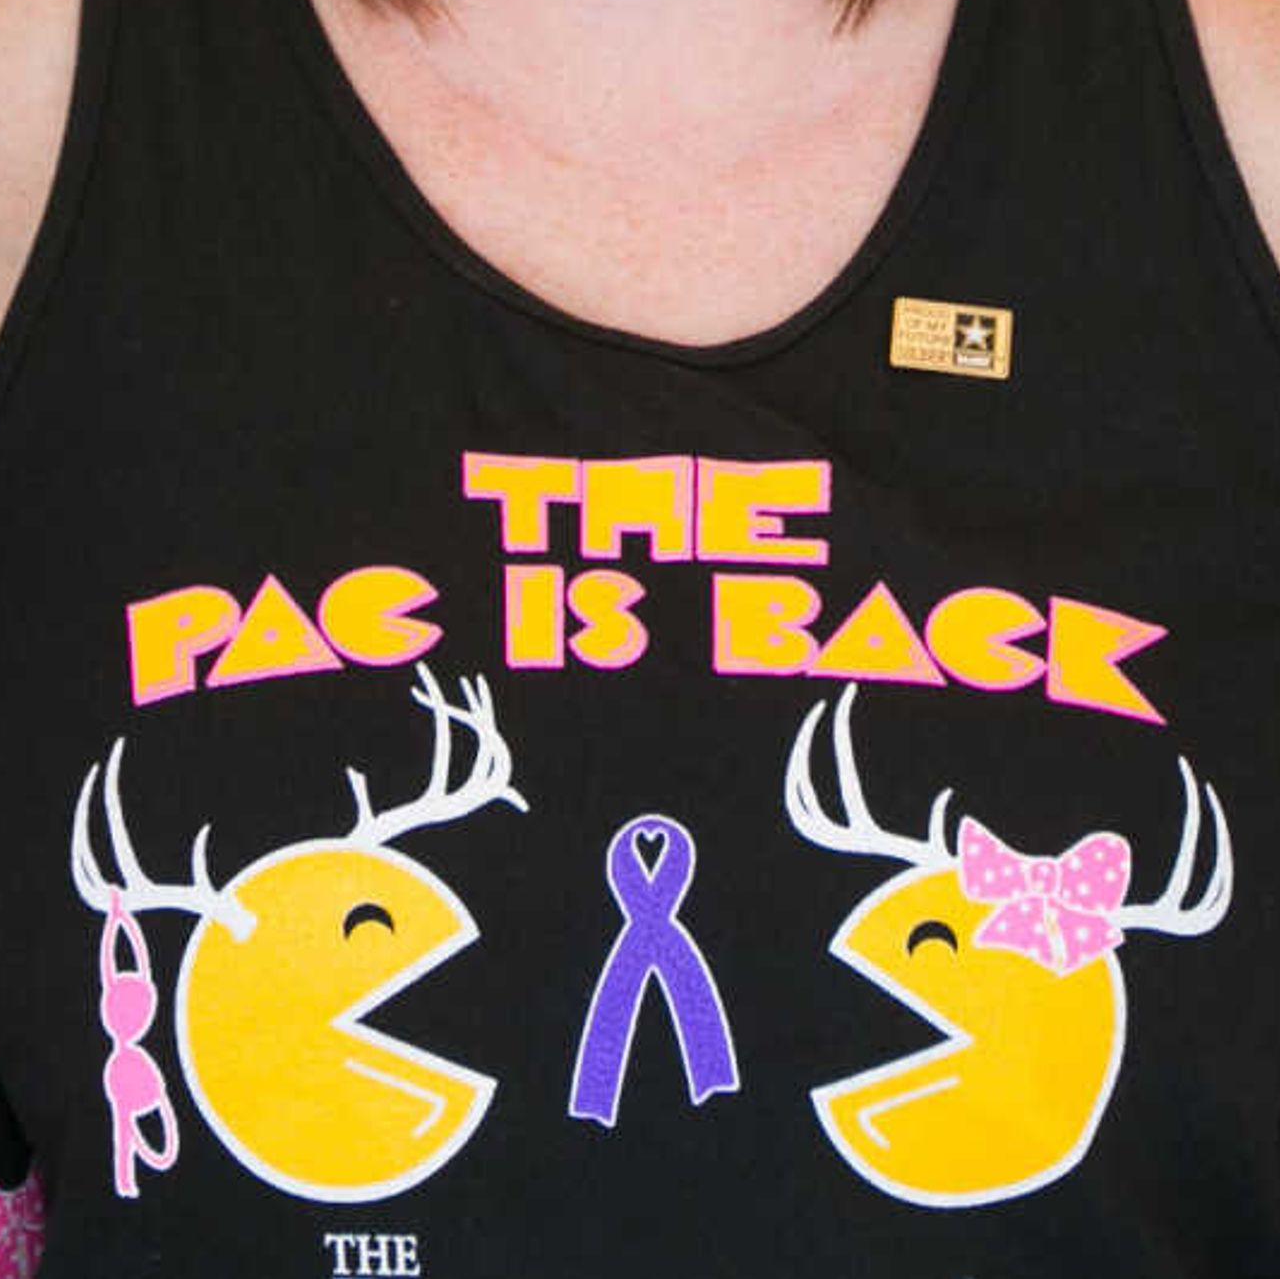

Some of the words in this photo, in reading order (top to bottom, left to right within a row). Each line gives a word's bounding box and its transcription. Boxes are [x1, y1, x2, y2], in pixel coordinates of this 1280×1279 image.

[461, 451, 832, 566] THE
[126, 565, 443, 706] PAC
[503, 564, 649, 670] IS
[711, 572, 1168, 725] BACK
[323, 1233, 421, 1277] THE
